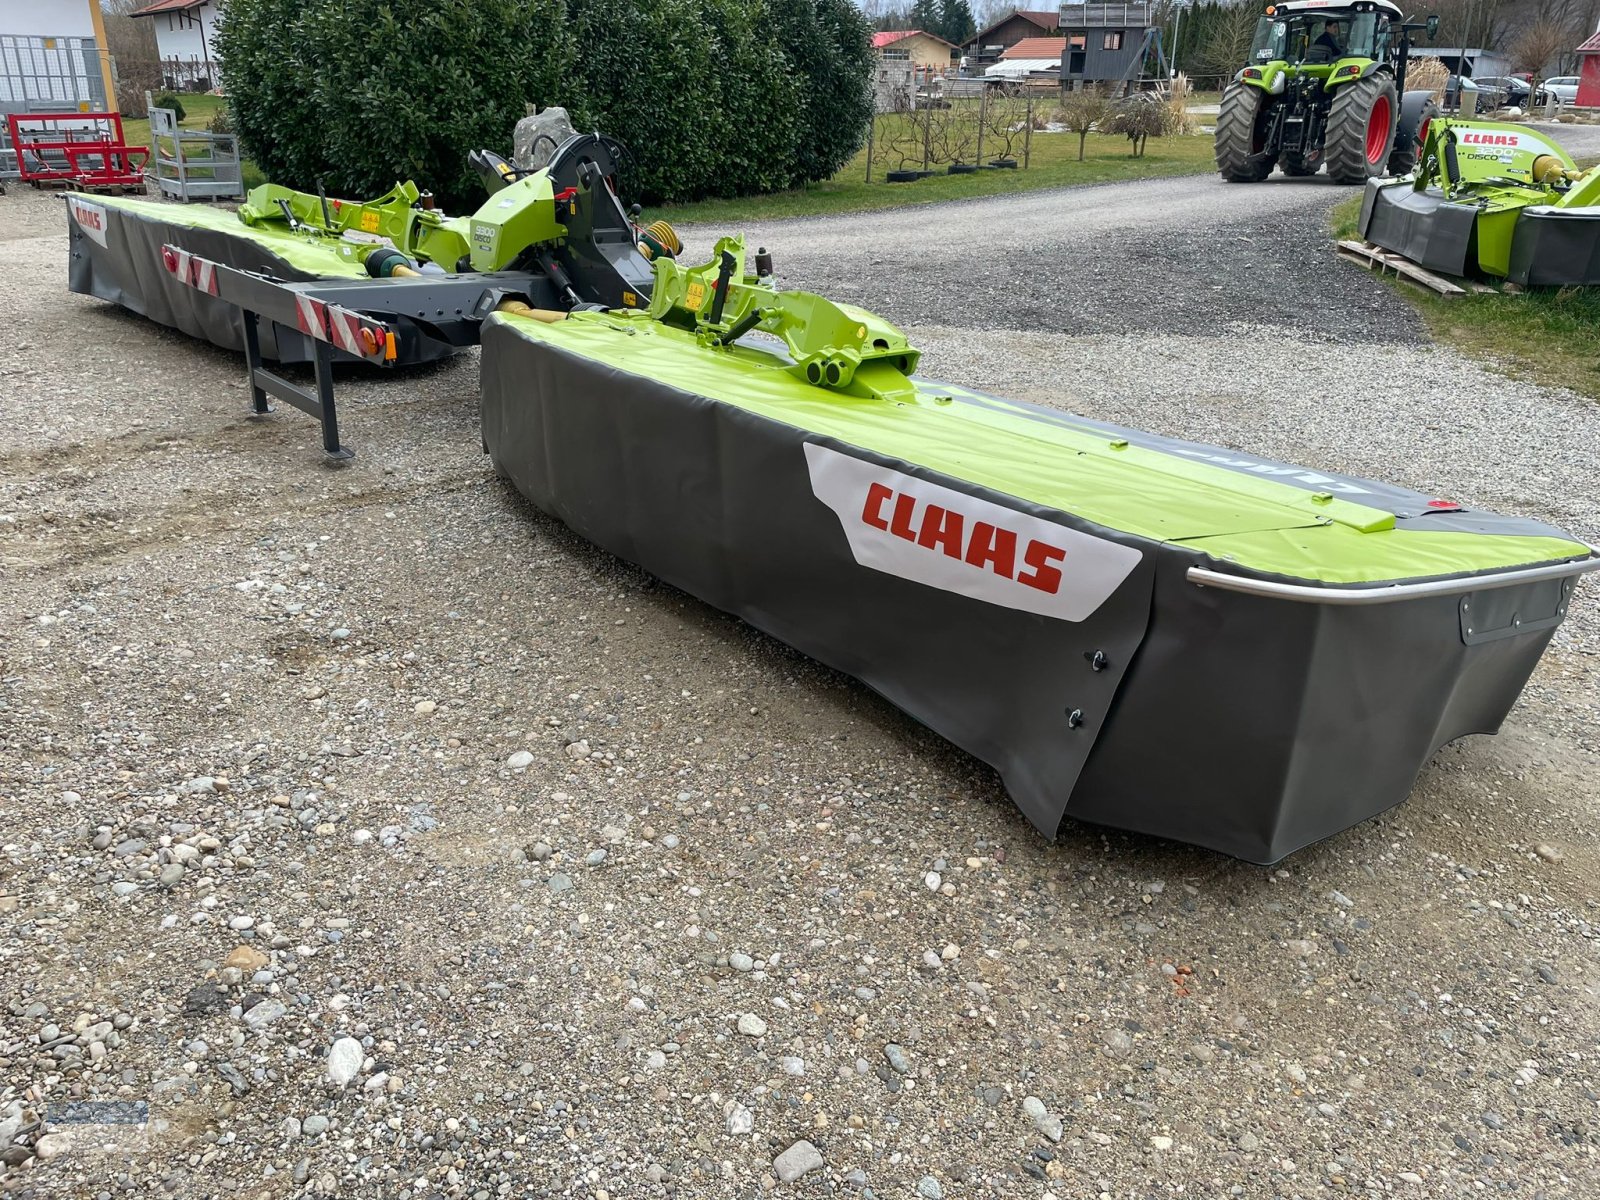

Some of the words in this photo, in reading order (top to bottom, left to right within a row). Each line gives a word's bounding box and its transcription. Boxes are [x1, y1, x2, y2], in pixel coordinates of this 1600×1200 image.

[1464, 134, 1518, 146] CLAAS
[1475, 146, 1514, 156] 3200
[76, 206, 100, 230] CLAAS
[476, 226, 495, 237] 9300
[474, 234, 490, 243] DISCO
[861, 481, 1066, 595] CLAAS
